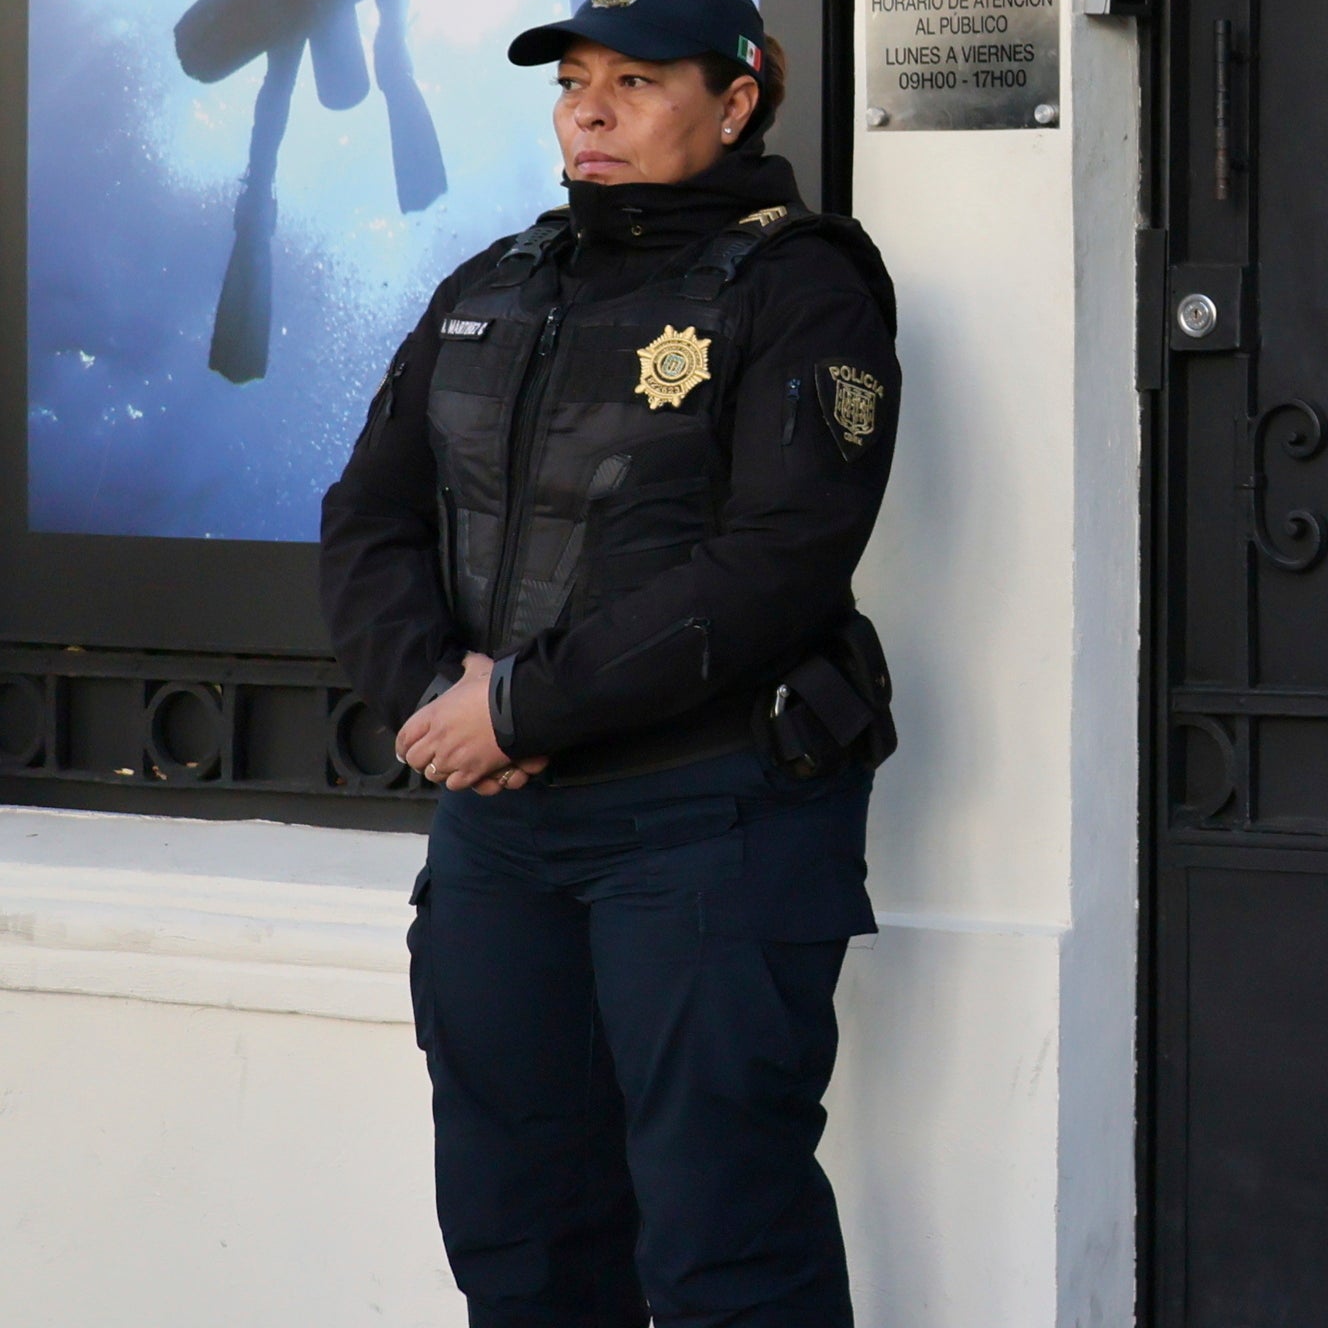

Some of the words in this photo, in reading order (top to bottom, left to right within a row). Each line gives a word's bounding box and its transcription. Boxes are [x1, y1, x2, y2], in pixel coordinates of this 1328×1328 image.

[915, 17, 936, 36] AL
[939, 12, 1008, 35] PÚBLICO
[885, 45, 941, 66] LUNES
[945, 45, 958, 64] A
[961, 43, 1035, 64] VIERNES
[898, 71, 957, 90] 09H00
[972, 69, 1027, 89] 17H00
[828, 364, 884, 399] POLICIA
